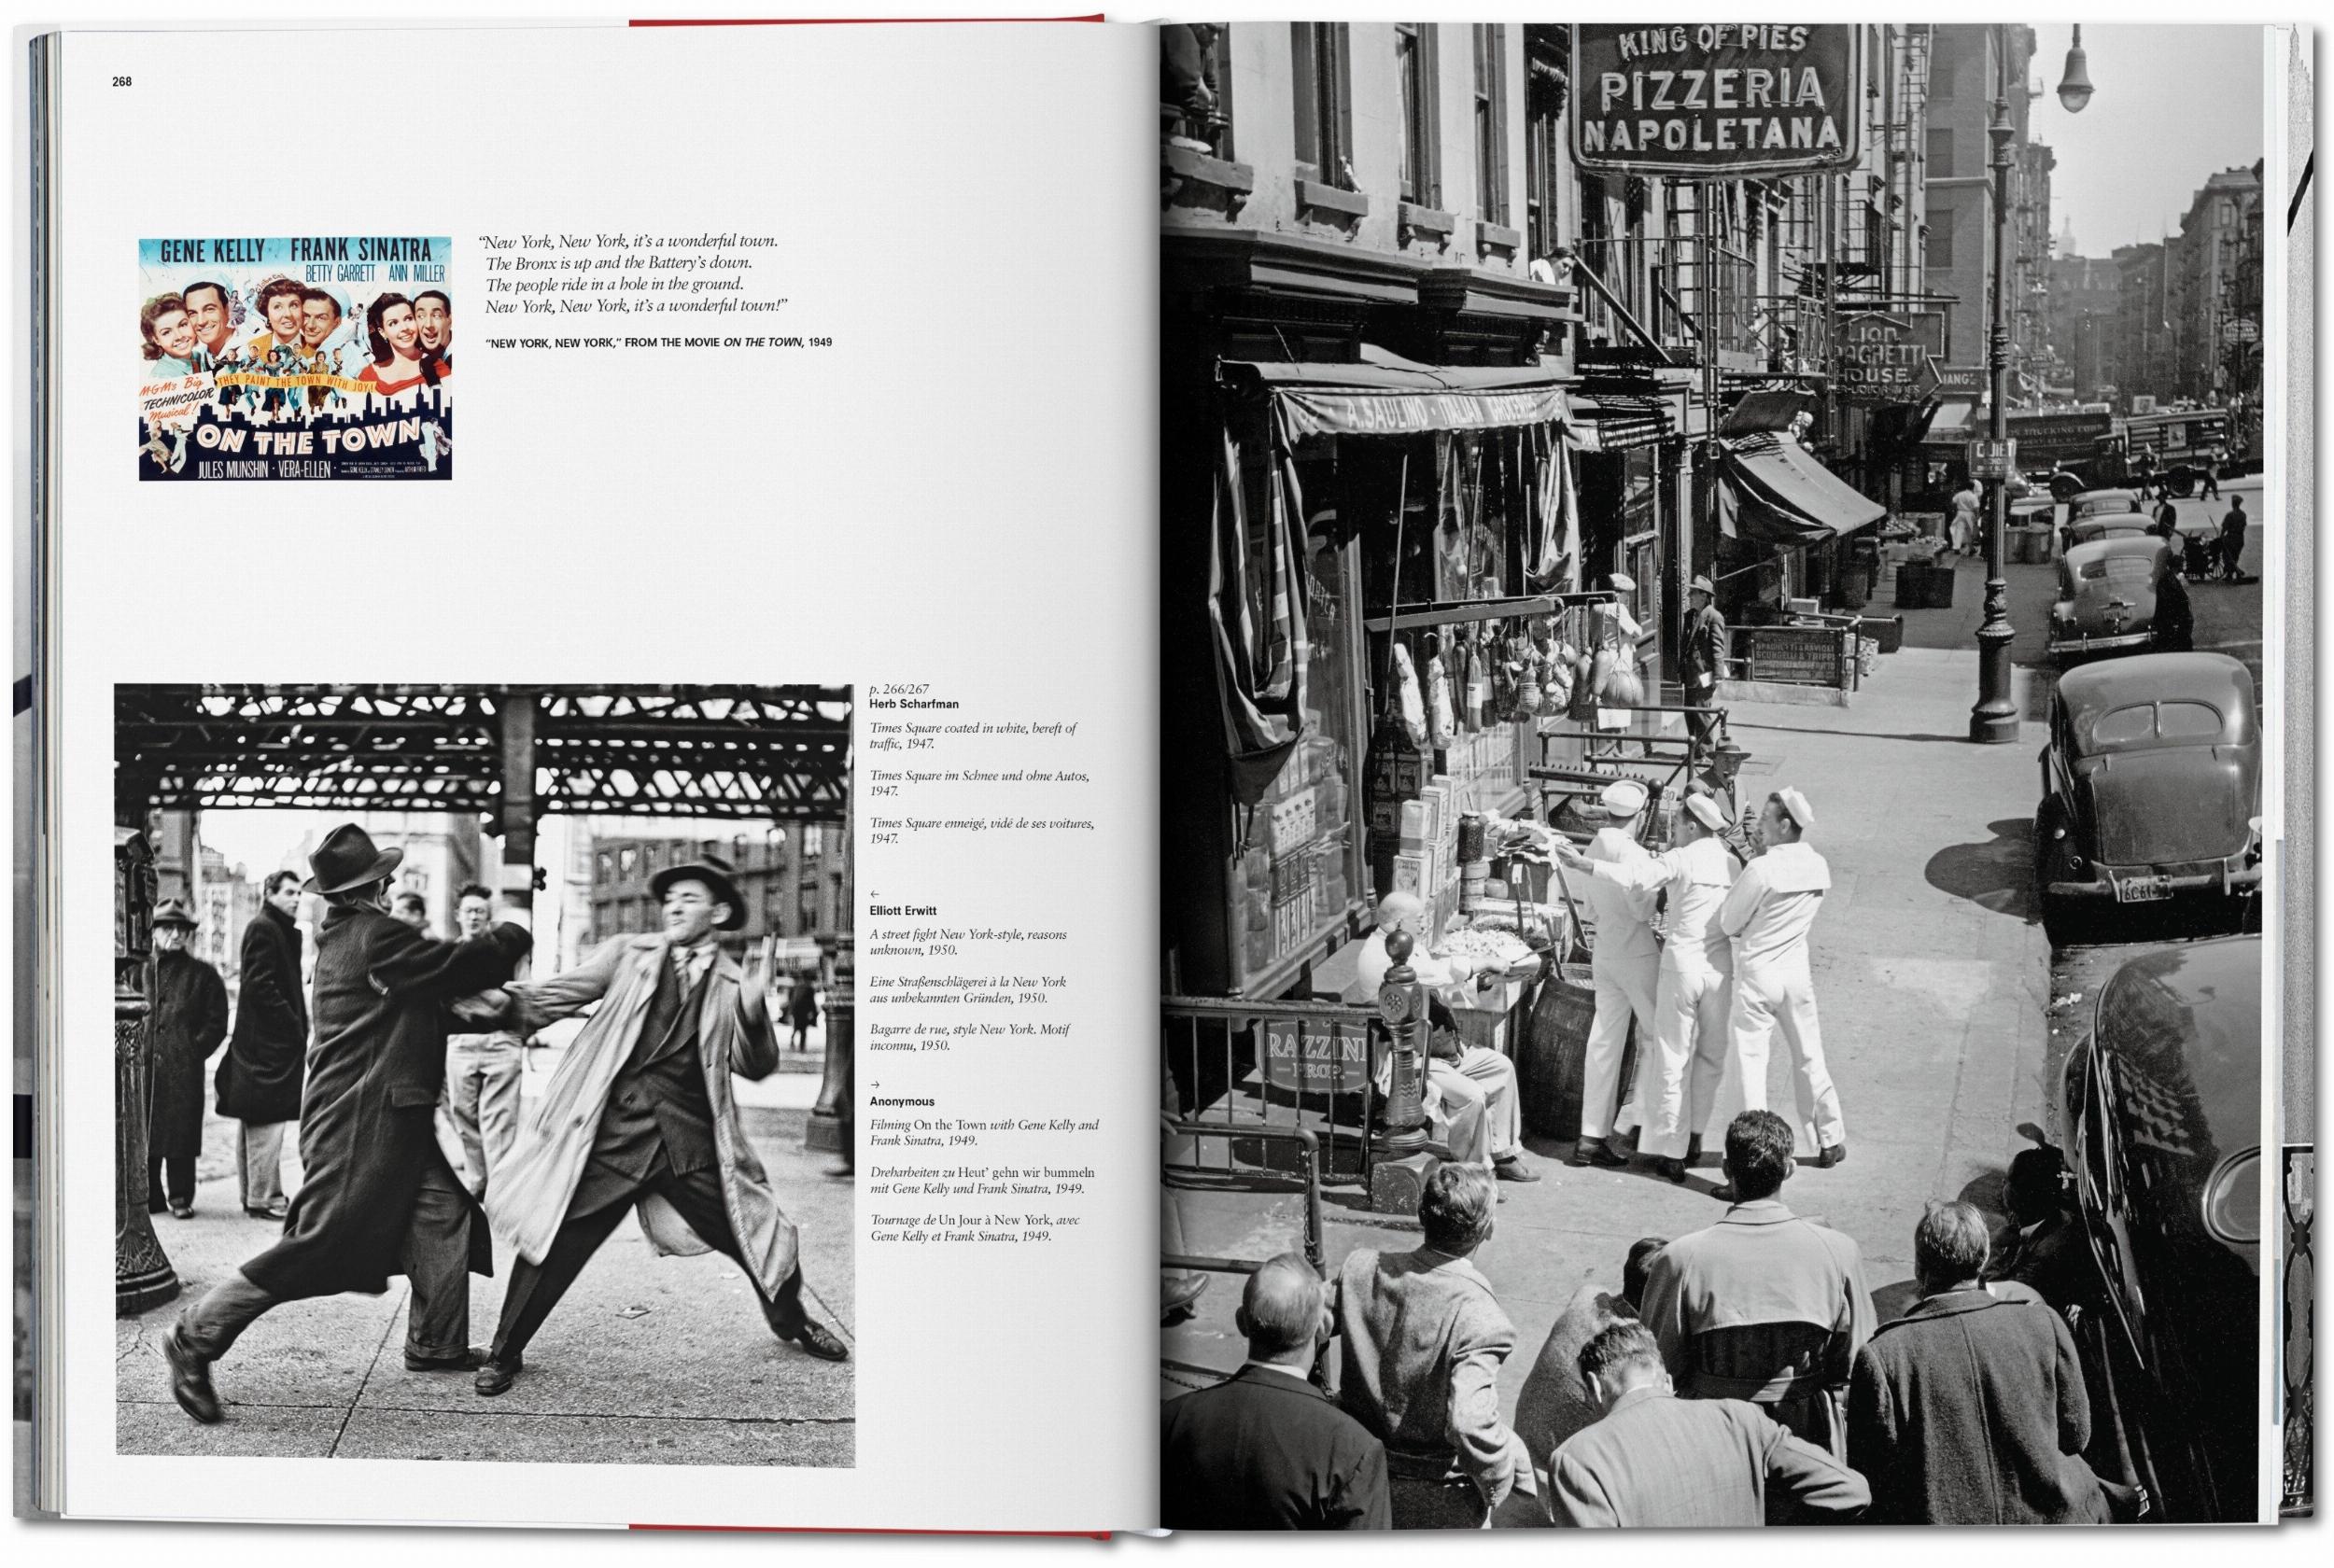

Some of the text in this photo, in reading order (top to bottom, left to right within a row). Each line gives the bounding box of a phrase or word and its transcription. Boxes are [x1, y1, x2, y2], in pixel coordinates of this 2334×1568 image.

[1619, 24, 1808, 61] KING OF PIES
[112, 76, 133, 88] 268
[1601, 66, 1825, 111] PIZZERIA
[1584, 116, 1841, 151] NAPOLETANA
[161, 238, 265, 262] GENE KELLY
[291, 237, 432, 261] FRANK SINATRA
[521, 233, 555, 251] York,
[558, 233, 592, 248] New
[596, 232, 629, 250] York,
[654, 237, 665, 247] a
[668, 232, 738, 251] wonderful
[739, 235, 778, 247] town.
[485, 256, 513, 272] The
[514, 257, 558, 271] Bronx
[560, 256, 571, 270] is
[573, 258, 593, 273] up
[594, 254, 622, 270] and
[624, 254, 645, 270] the
[709, 254, 752, 270] down.
[305, 264, 375, 282] BETTY GARRETT
[388, 264, 445, 282] ANN MILLER
[485, 275, 744, 296] The people ride in a hole in the ground.
[485, 300, 518, 314] New
[522, 298, 556, 315] York,
[558, 299, 593, 314] New
[597, 297, 630, 315] York,
[655, 302, 666, 313] a
[668, 296, 738, 315] wonderful
[519, 338, 553, 350] YORK,
[555, 337, 582, 349] NEW
[625, 337, 658, 348] FROM
[660, 337, 682, 348] THE
[683, 337, 721, 348] MOVIE
[723, 337, 742, 348] ON
[744, 336, 766, 348] THE
[767, 336, 805, 349] TOWN,
[808, 336, 833, 347] 1949
[183, 376, 204, 390] Big
[218, 375, 373, 392] THEY PAINT THE TOWN WITH JOY!
[144, 387, 215, 411] TECHNICOLOR
[196, 416, 421, 455] ON THE TOWN
[198, 461, 269, 479] JULES MUNSHIN
[278, 460, 331, 479] VERA-ELLEN
[868, 683, 931, 698] p. 266/267
[869, 698, 960, 709] Herb Scharfman
[870, 721, 1079, 737] Times Square coated in white, bereft of
[869, 736, 935, 752] traffic, 1947.
[870, 769, 1090, 785] Times Square im Schnee und ohne Autos,
[870, 785, 899, 797] 1947.
[869, 904, 938, 917] Elliott Erwitt
[869, 927, 1068, 944] A street fight New York-style, reasons
[868, 975, 1067, 990] Eine Straßenschlägerei à la New York
[869, 991, 1048, 1006] aus unbekannten Gründen, 1950.
[869, 1095, 935, 1109] Anonymous
[870, 1118, 1101, 1134] Filming On the Town with Gene Kelly and
[870, 1134, 978, 1148] Frank Sinatra, 1949.
[870, 1166, 940, 1178] Dreharbeiten
[941, 1169, 956, 1179] zu
[991, 1166, 1019, 1181] gehn
[1021, 1167, 1041, 1178] wir
[1044, 1166, 1095, 1179] bummeln
